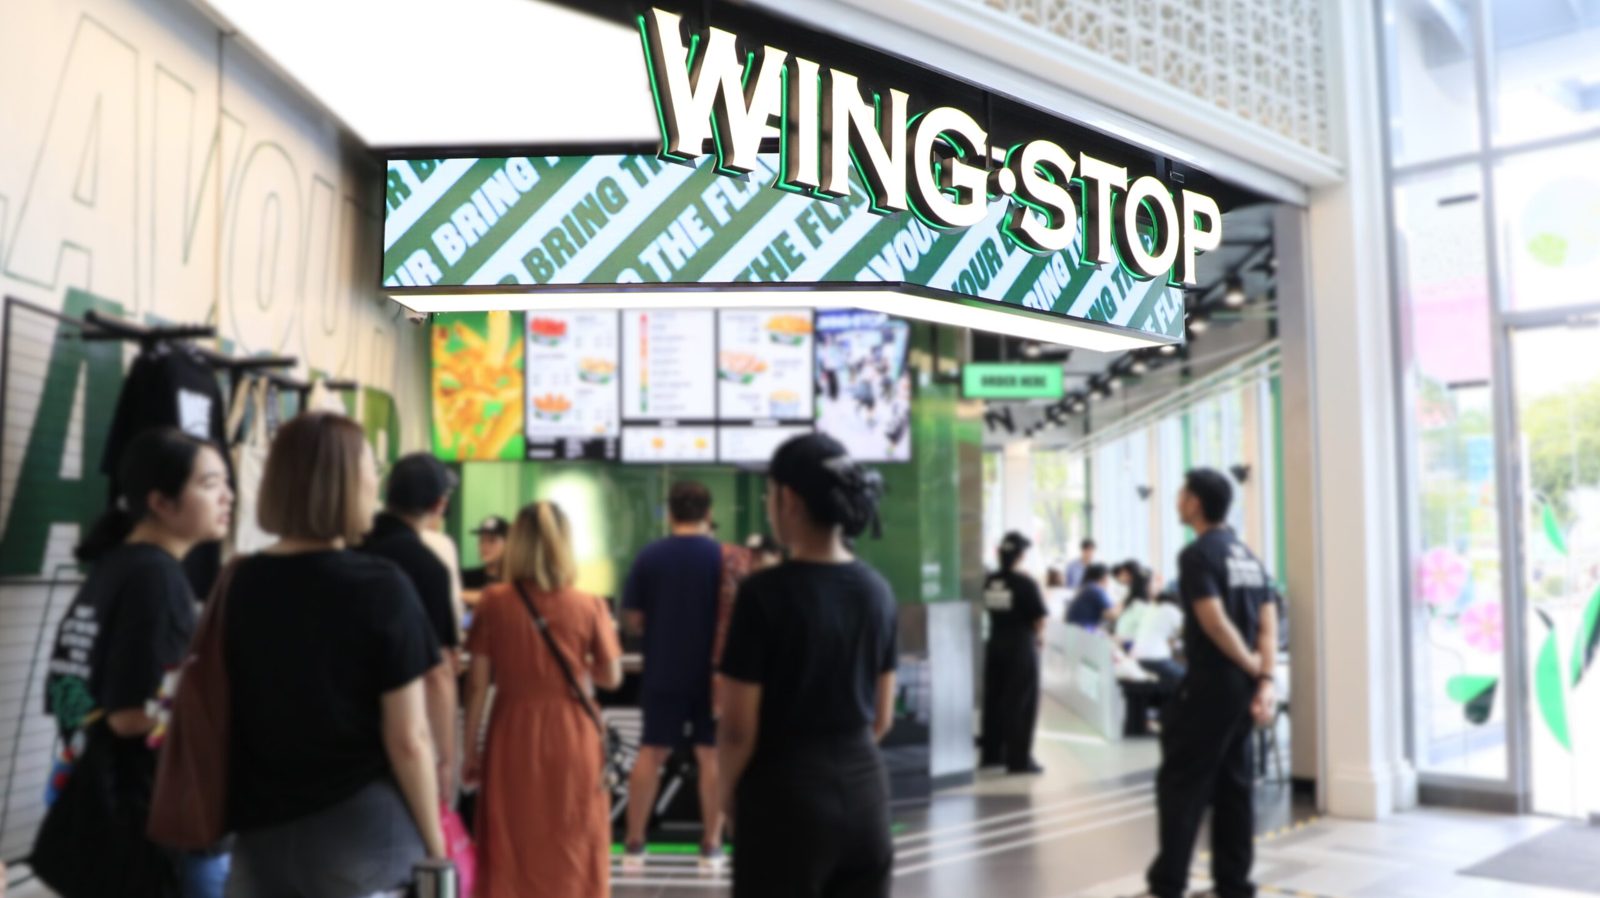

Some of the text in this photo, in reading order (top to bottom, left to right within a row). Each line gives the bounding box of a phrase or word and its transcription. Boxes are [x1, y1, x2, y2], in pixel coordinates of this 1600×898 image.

[431, 156, 541, 267] BRING
[520, 175, 629, 285] BRING
[637, 203, 714, 282] THE
